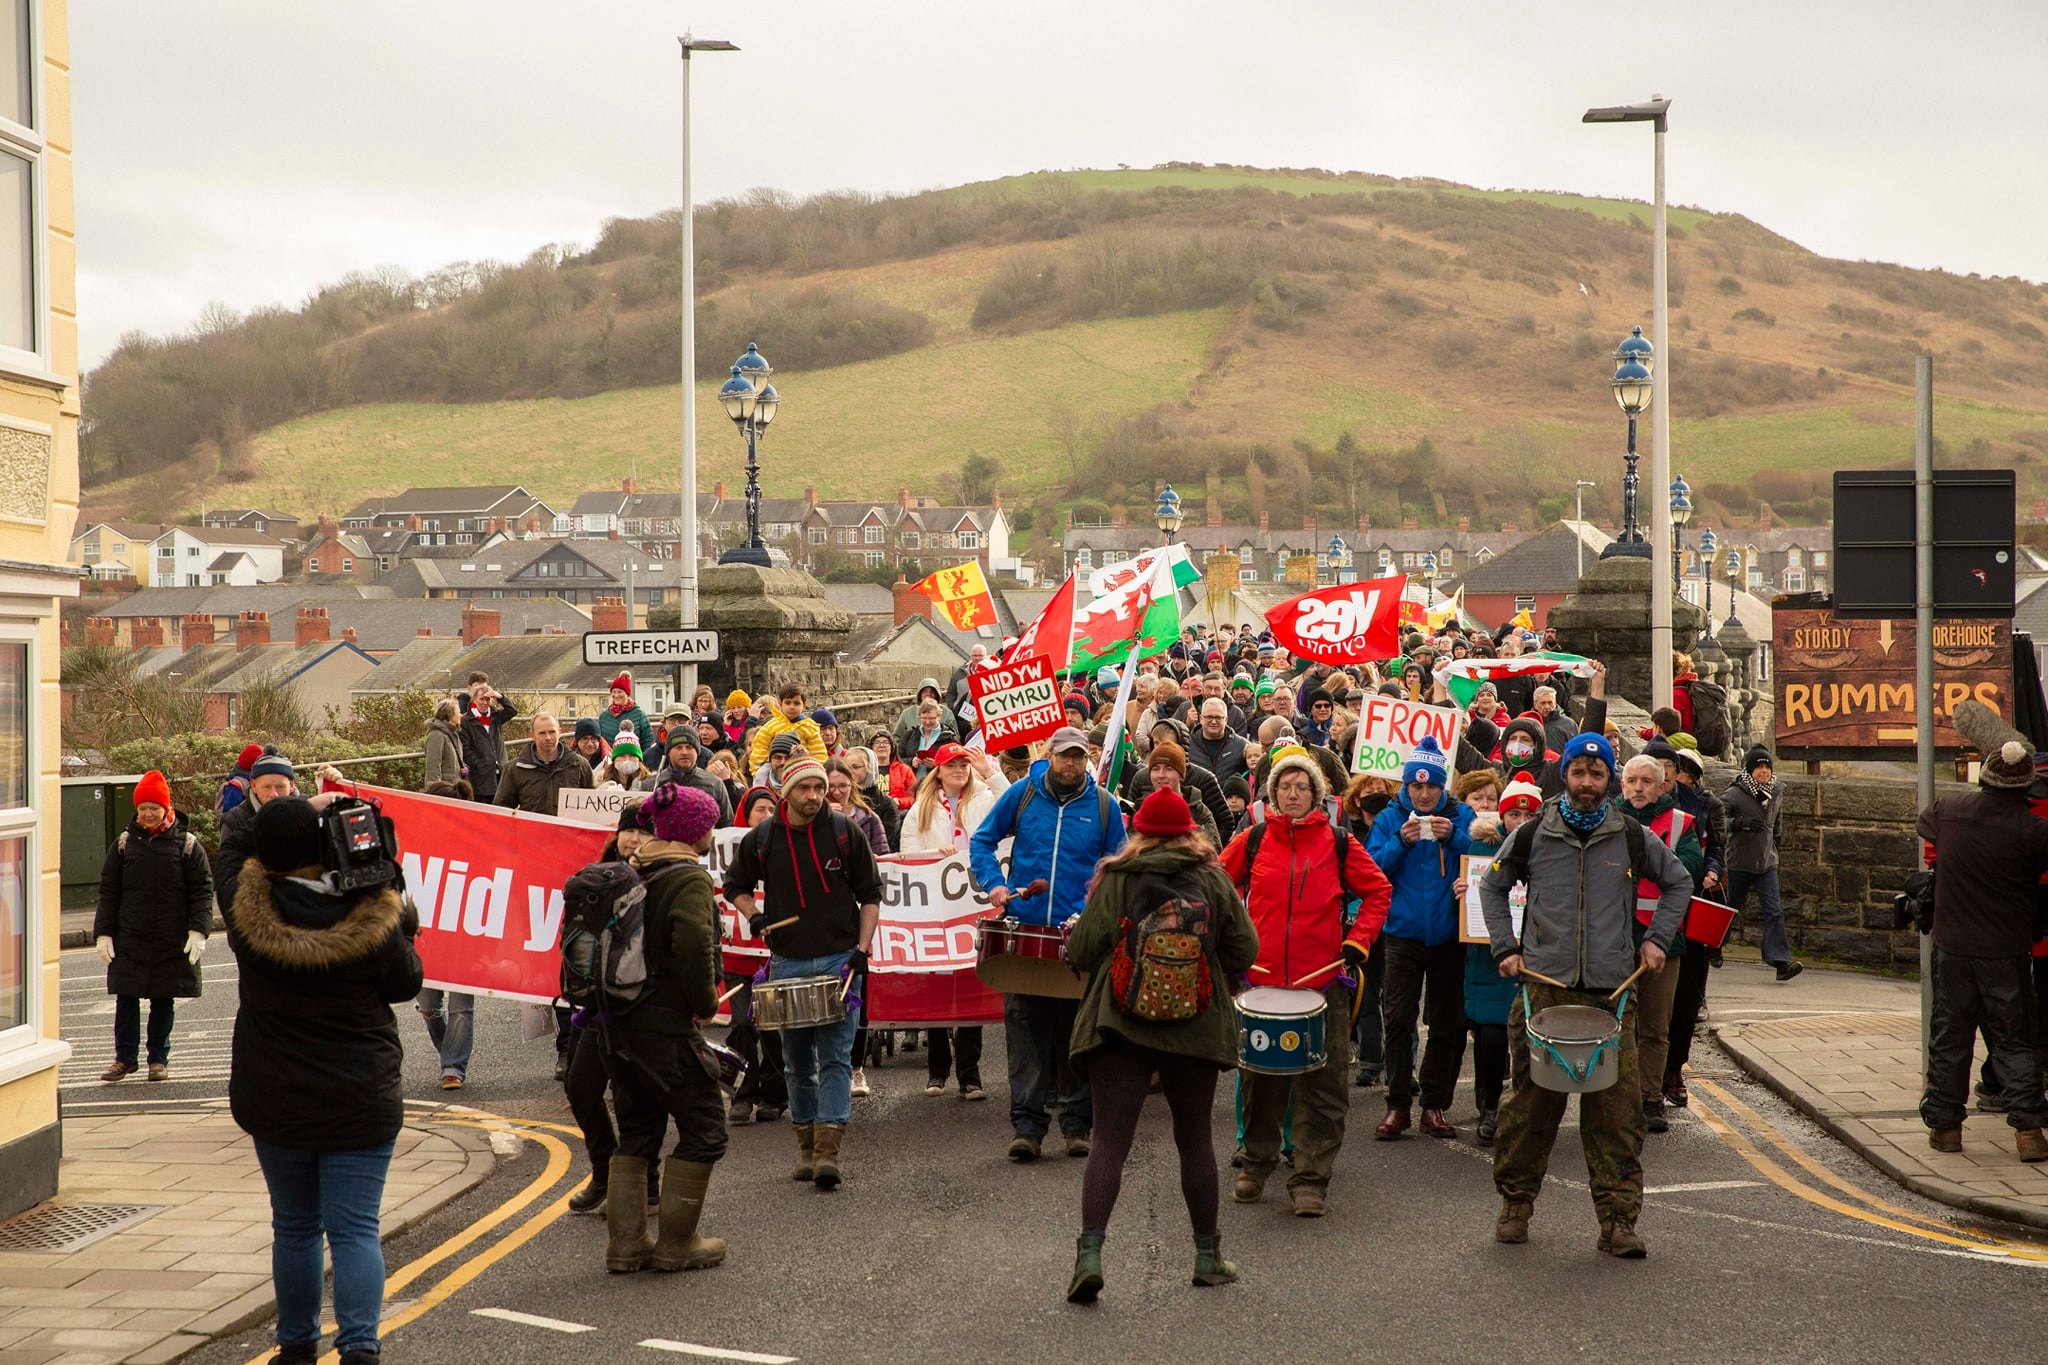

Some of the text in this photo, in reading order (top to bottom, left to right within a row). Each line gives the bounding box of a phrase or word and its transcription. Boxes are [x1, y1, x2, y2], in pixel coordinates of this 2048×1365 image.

[595, 639, 710, 656] TREFECHAN
[1795, 628, 1851, 649] STORDY
[1933, 625, 1996, 647] OREHOUSE
[980, 660, 1042, 694] NID YW
[984, 684, 1051, 715] CYMRU
[985, 703, 1062, 741] AR WERTH
[1365, 700, 1456, 750] FRON
[94, 789, 102, 800] 5
[565, 793, 646, 813] LLANBE
[401, 852, 513, 939] Nid
